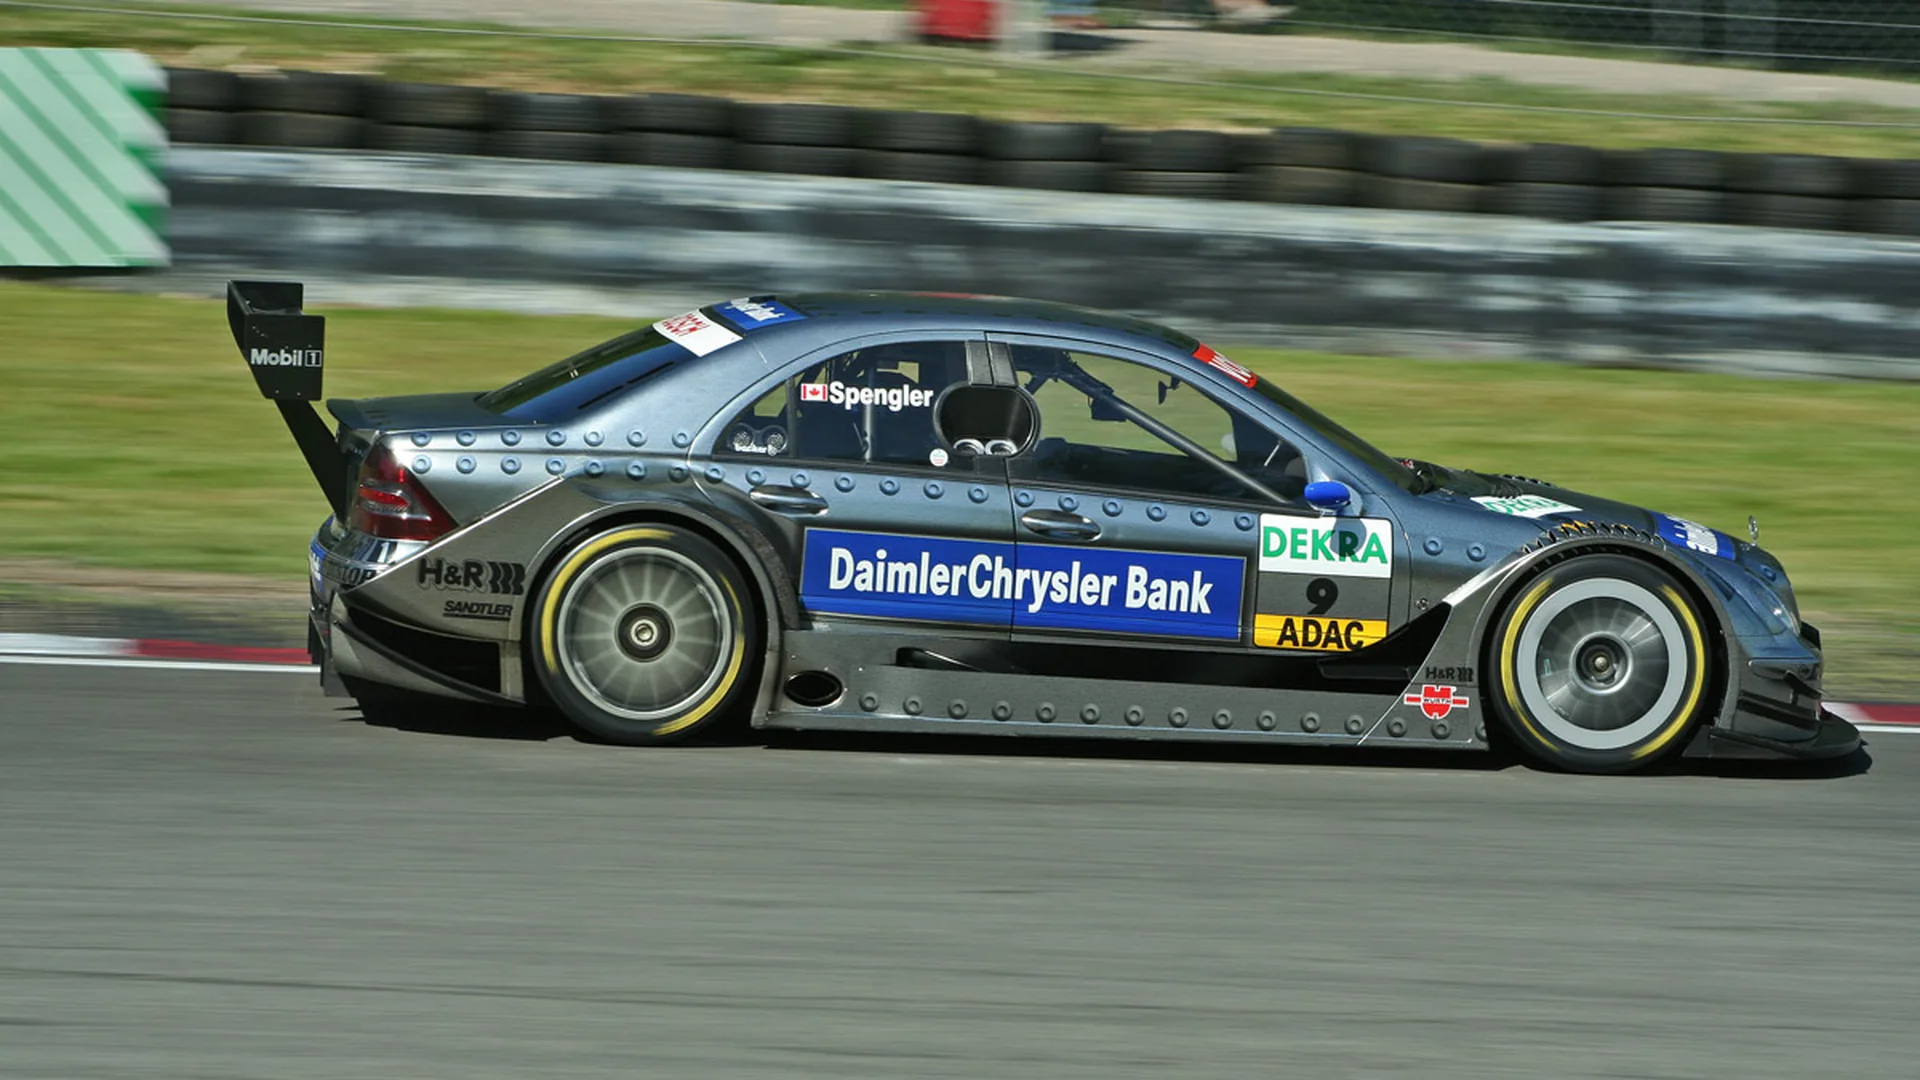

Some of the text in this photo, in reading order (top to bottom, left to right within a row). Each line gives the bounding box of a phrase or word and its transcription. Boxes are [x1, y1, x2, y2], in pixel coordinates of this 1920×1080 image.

[251, 349, 302, 366] Mobil
[829, 381, 933, 412] Spengler
[1263, 526, 1388, 564] DEKRA
[418, 558, 484, 588] H&R
[829, 547, 1213, 614] DaimlerChrysler Bank
[444, 600, 513, 616] SANDTLER
[1306, 577, 1339, 615] 9
[1276, 618, 1364, 650] ADAC
[1426, 666, 1455, 680] H&R
